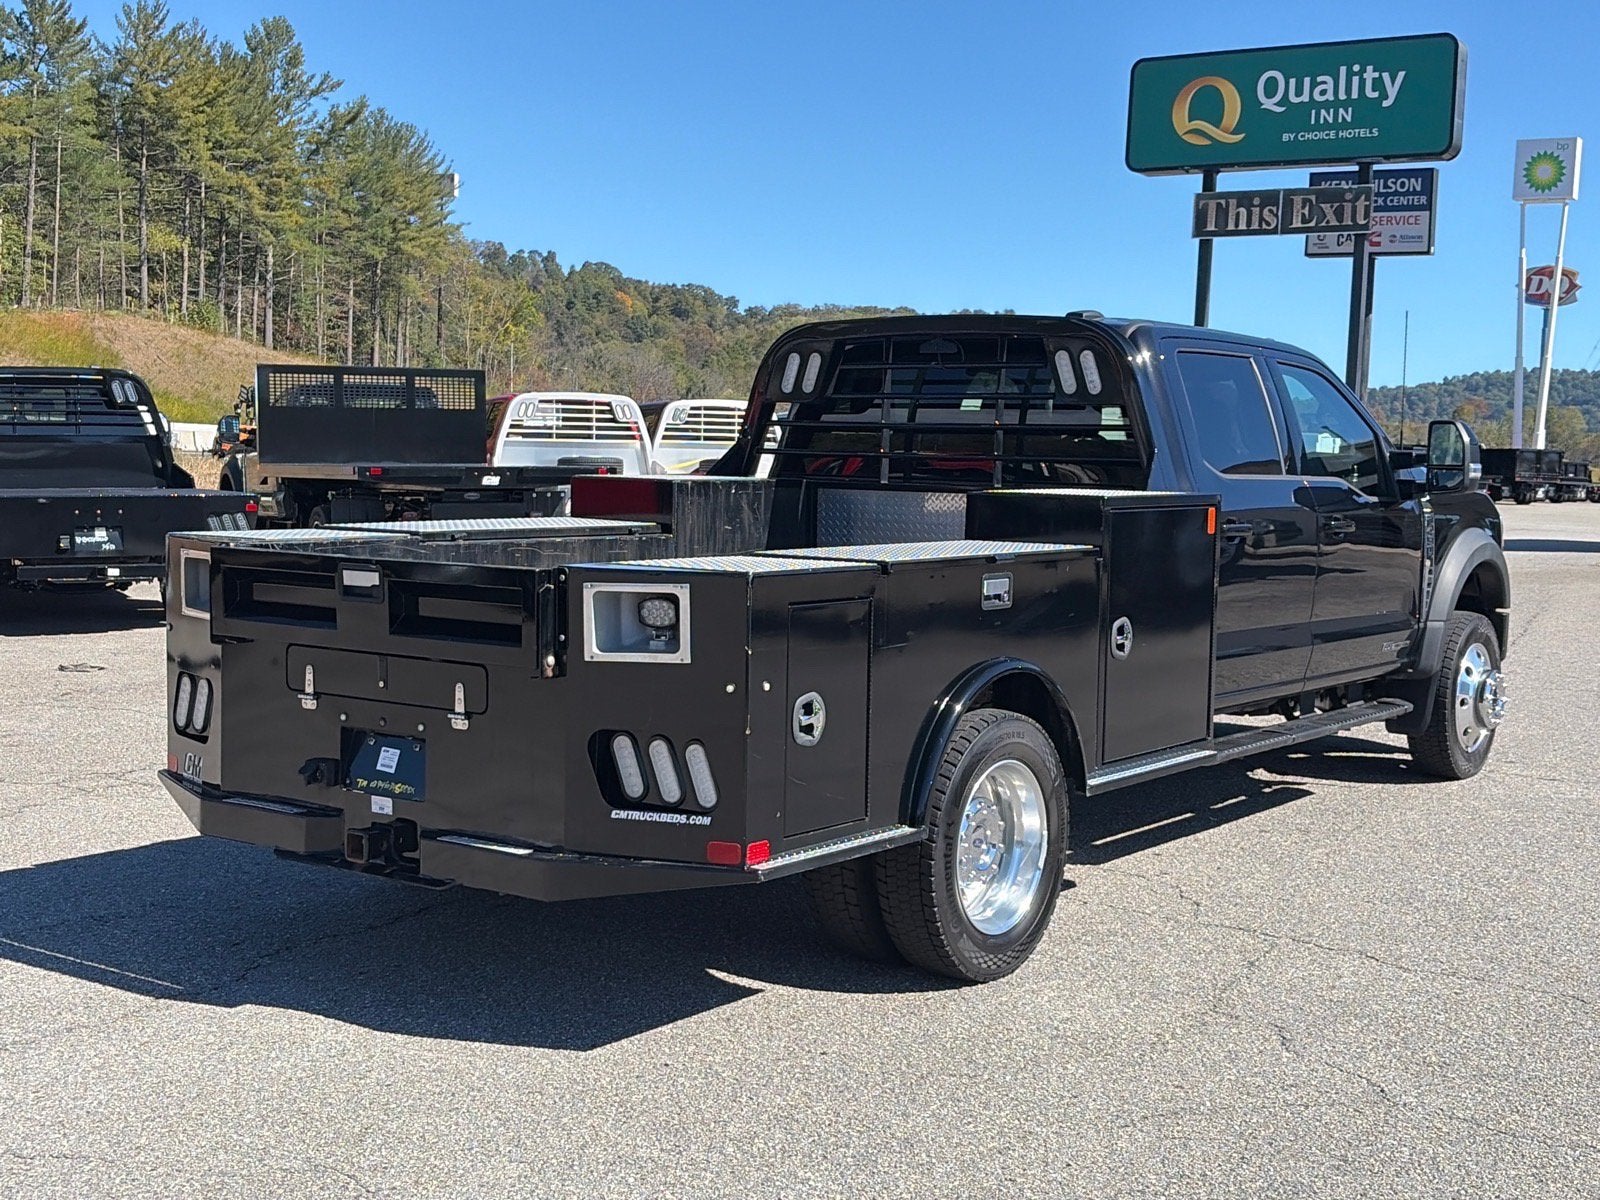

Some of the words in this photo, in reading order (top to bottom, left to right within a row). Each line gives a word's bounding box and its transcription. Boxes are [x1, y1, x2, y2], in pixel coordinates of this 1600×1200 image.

[1256, 64, 1406, 113] Quality
[1310, 107, 1352, 125] INN
[1282, 132, 1296, 142] BY
[1298, 130, 1337, 141] CHOICE
[1338, 128, 1379, 139] HOTELS
[1556, 141, 1570, 152] bp
[1372, 177, 1422, 193] ILSON
[1386, 195, 1428, 206] CENTER
[1199, 196, 1278, 232] This
[1288, 192, 1370, 229] Exit
[1372, 214, 1422, 227] SERVICE
[1337, 233, 1354, 248] CA
[610, 809, 712, 826] CMTRUCKBEDS.COM
